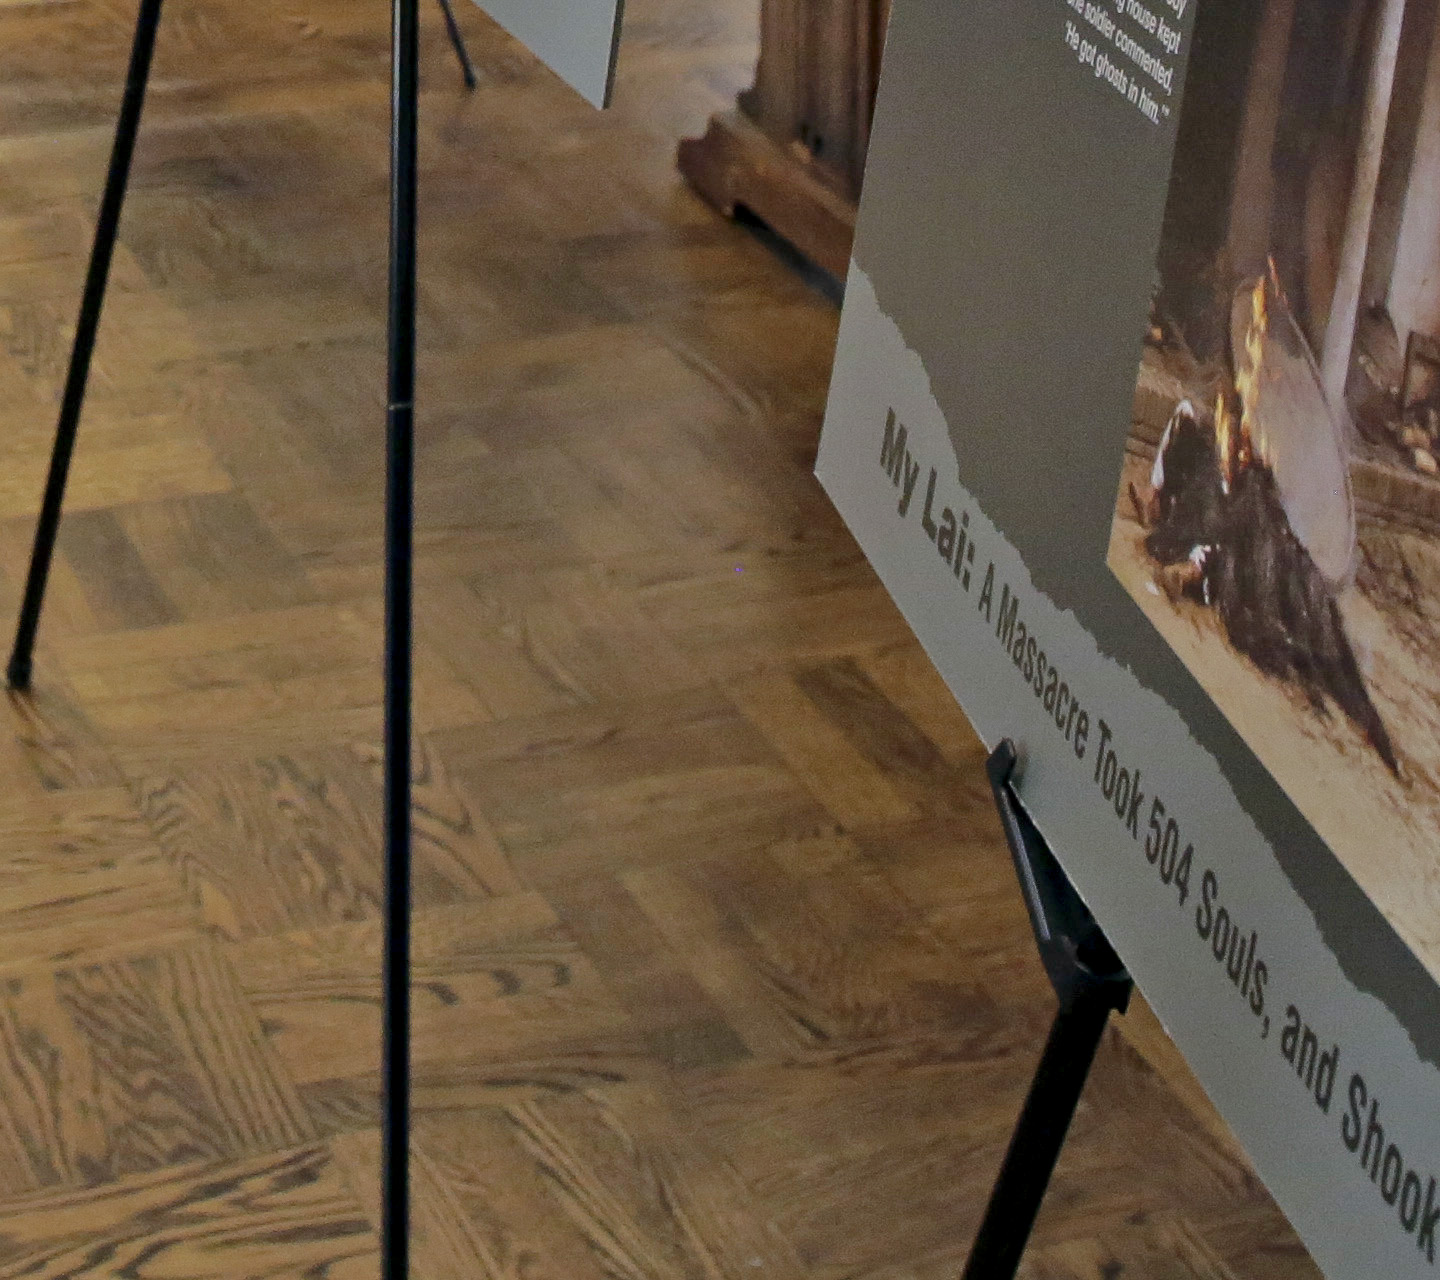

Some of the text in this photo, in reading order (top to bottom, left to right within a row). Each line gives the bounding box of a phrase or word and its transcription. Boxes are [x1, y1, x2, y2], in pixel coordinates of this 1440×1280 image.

[1078, 39, 1097, 66] got
[1094, 53, 1128, 95] ghosts
[1127, 77, 1139, 104] in
[1084, 2, 1116, 40] soldier
[1115, 29, 1174, 96] commented,
[1157, 17, 1182, 54] kept
[880, 406, 919, 518] My
[921, 466, 975, 593] Lai:
[978, 560, 995, 624] A
[995, 582, 1091, 760] Massacre
[1092, 718, 1145, 840] Took
[1144, 796, 1194, 906] 504
[1195, 868, 1271, 1039] Souls,
[1281, 1003, 1340, 1114] and
